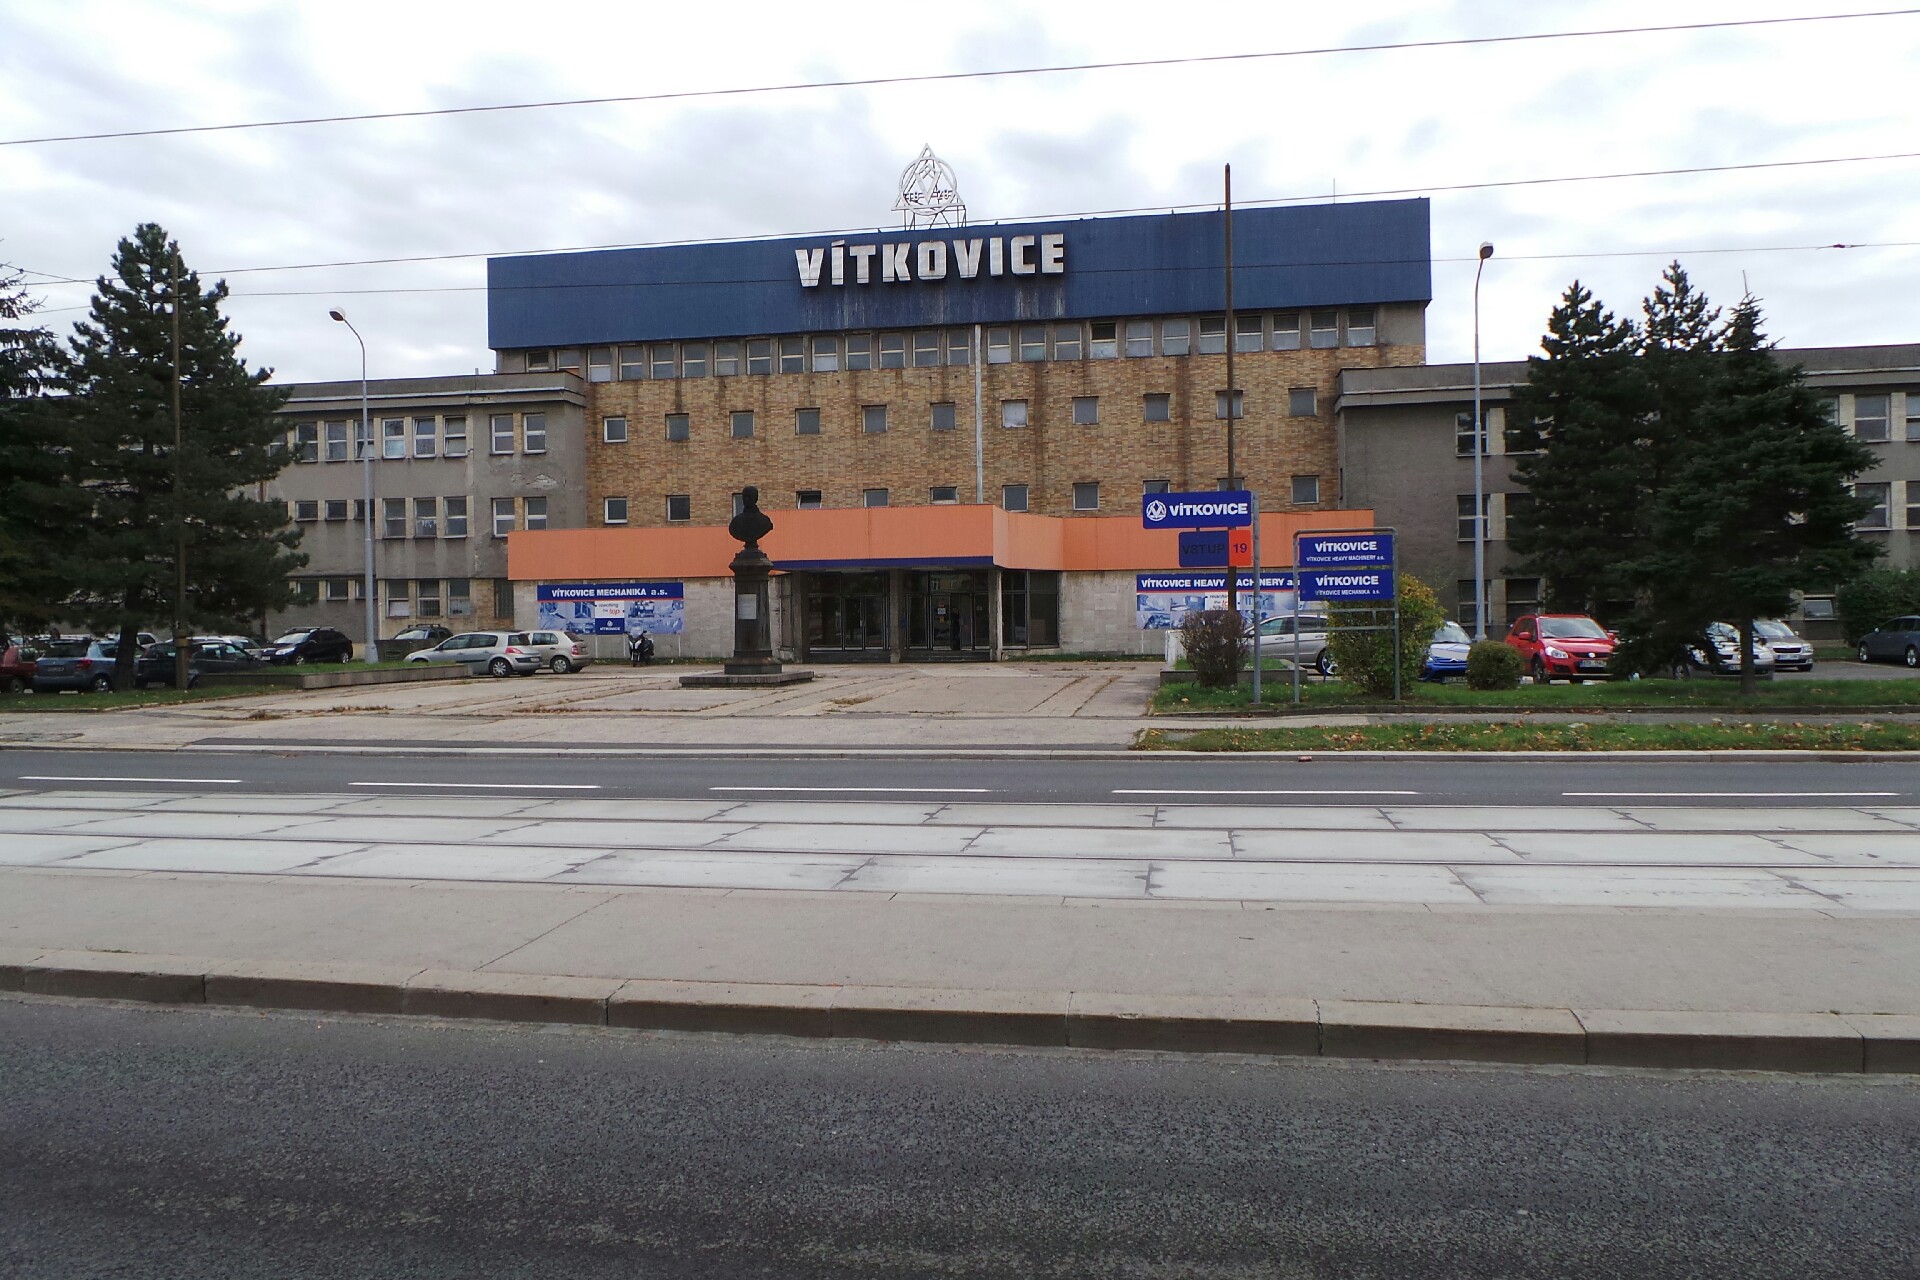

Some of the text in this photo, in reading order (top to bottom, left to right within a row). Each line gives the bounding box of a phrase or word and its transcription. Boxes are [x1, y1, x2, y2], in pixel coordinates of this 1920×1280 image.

[795, 233, 1064, 287] VÍTKOVICE
[1169, 502, 1248, 517] VÍTKOVICE
[1182, 542, 1248, 555] VSTUP 19
[1315, 541, 1377, 552] VÍTKOVICE
[1141, 577, 1191, 588] VÍTKOVICE
[1193, 578, 1225, 587] HEAVY
[1315, 574, 1379, 586] VÍTKOVICE
[551, 587, 595, 597] VÍTKOVICE
[596, 588, 647, 597] MECHANIKA
